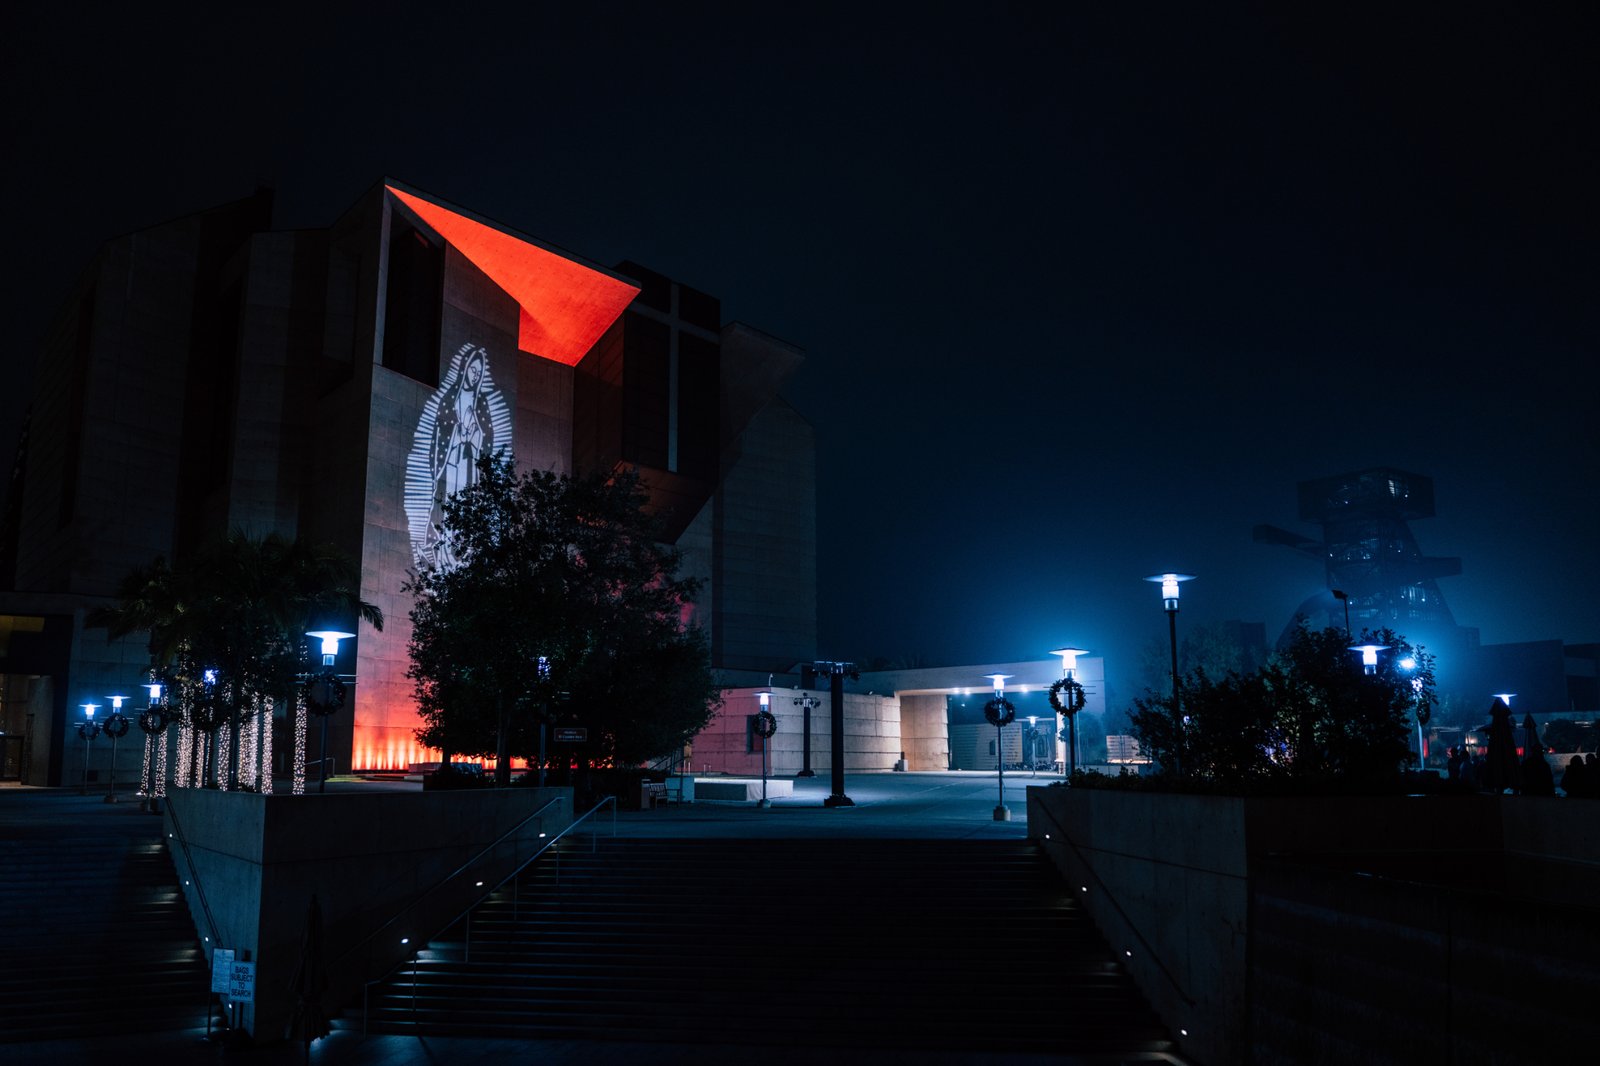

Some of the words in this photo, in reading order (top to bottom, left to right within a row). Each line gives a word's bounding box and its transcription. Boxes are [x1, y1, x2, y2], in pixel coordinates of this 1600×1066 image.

[235, 966, 249, 974] BAGS
[231, 973, 253, 982] SUBJECT
[231, 989, 251, 998] SEARCH
